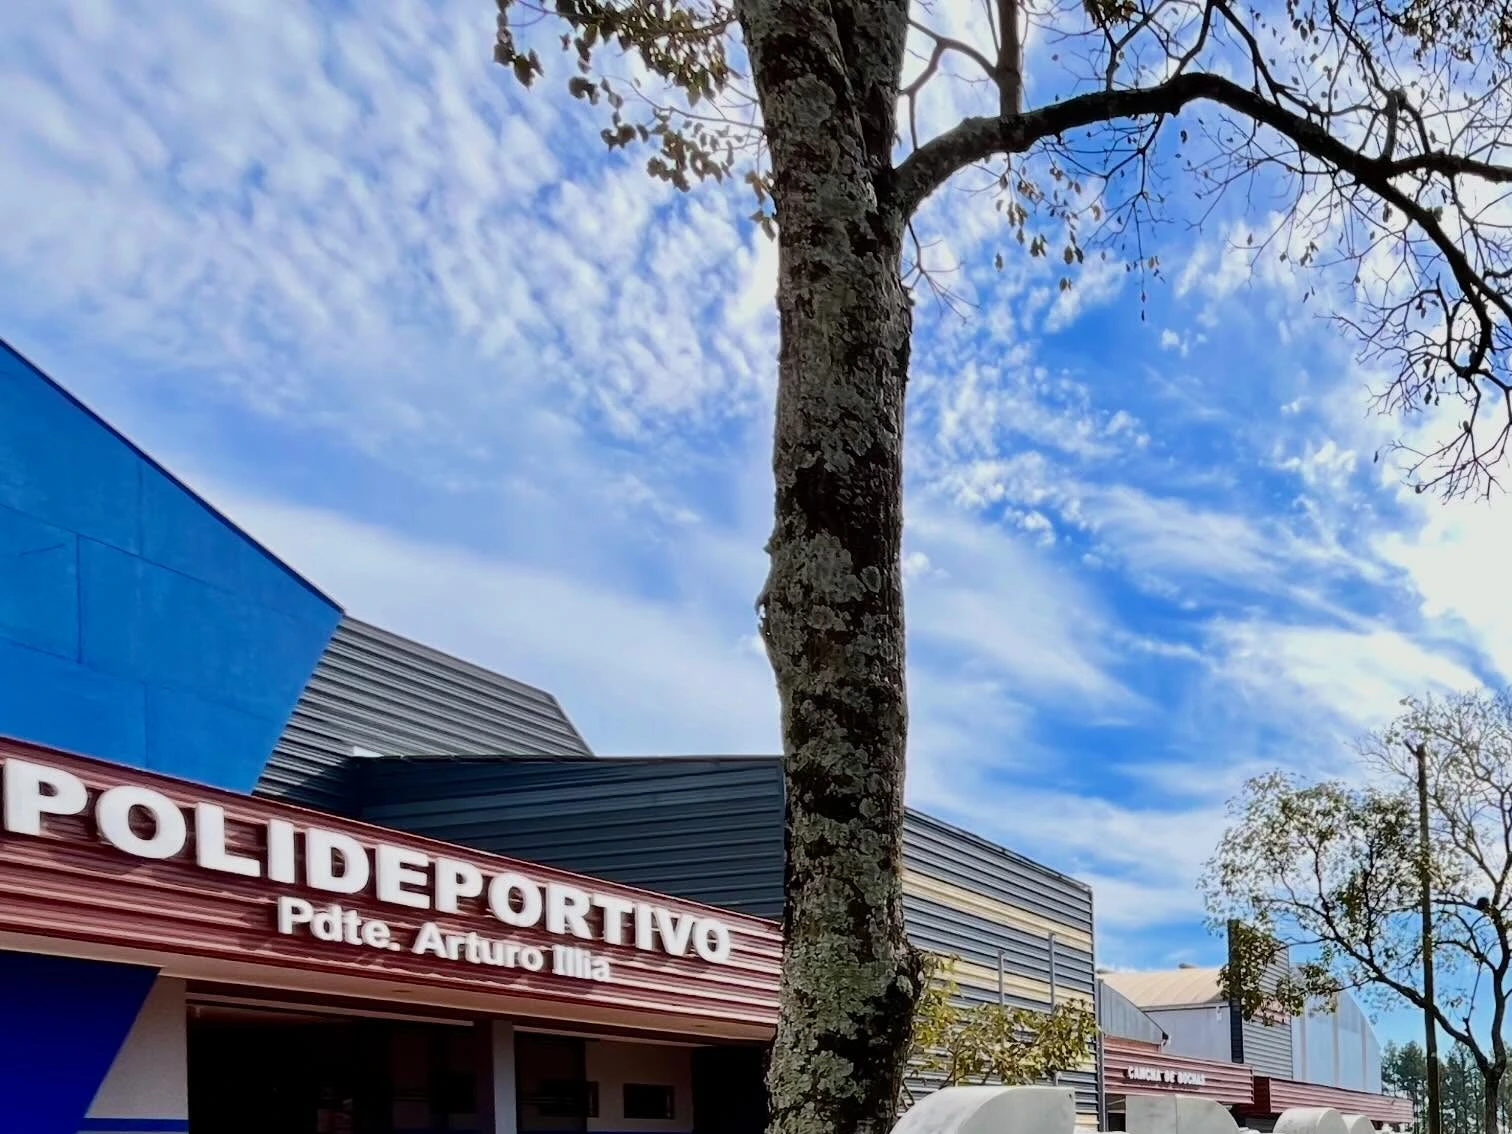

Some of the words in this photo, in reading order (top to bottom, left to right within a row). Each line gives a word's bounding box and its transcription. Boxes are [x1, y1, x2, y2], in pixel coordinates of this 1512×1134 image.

[3, 758, 732, 964] POLIDEPORTIVO
[278, 896, 400, 951] Pdte.
[411, 922, 544, 971] Arturo
[551, 944, 611, 982] Illia
